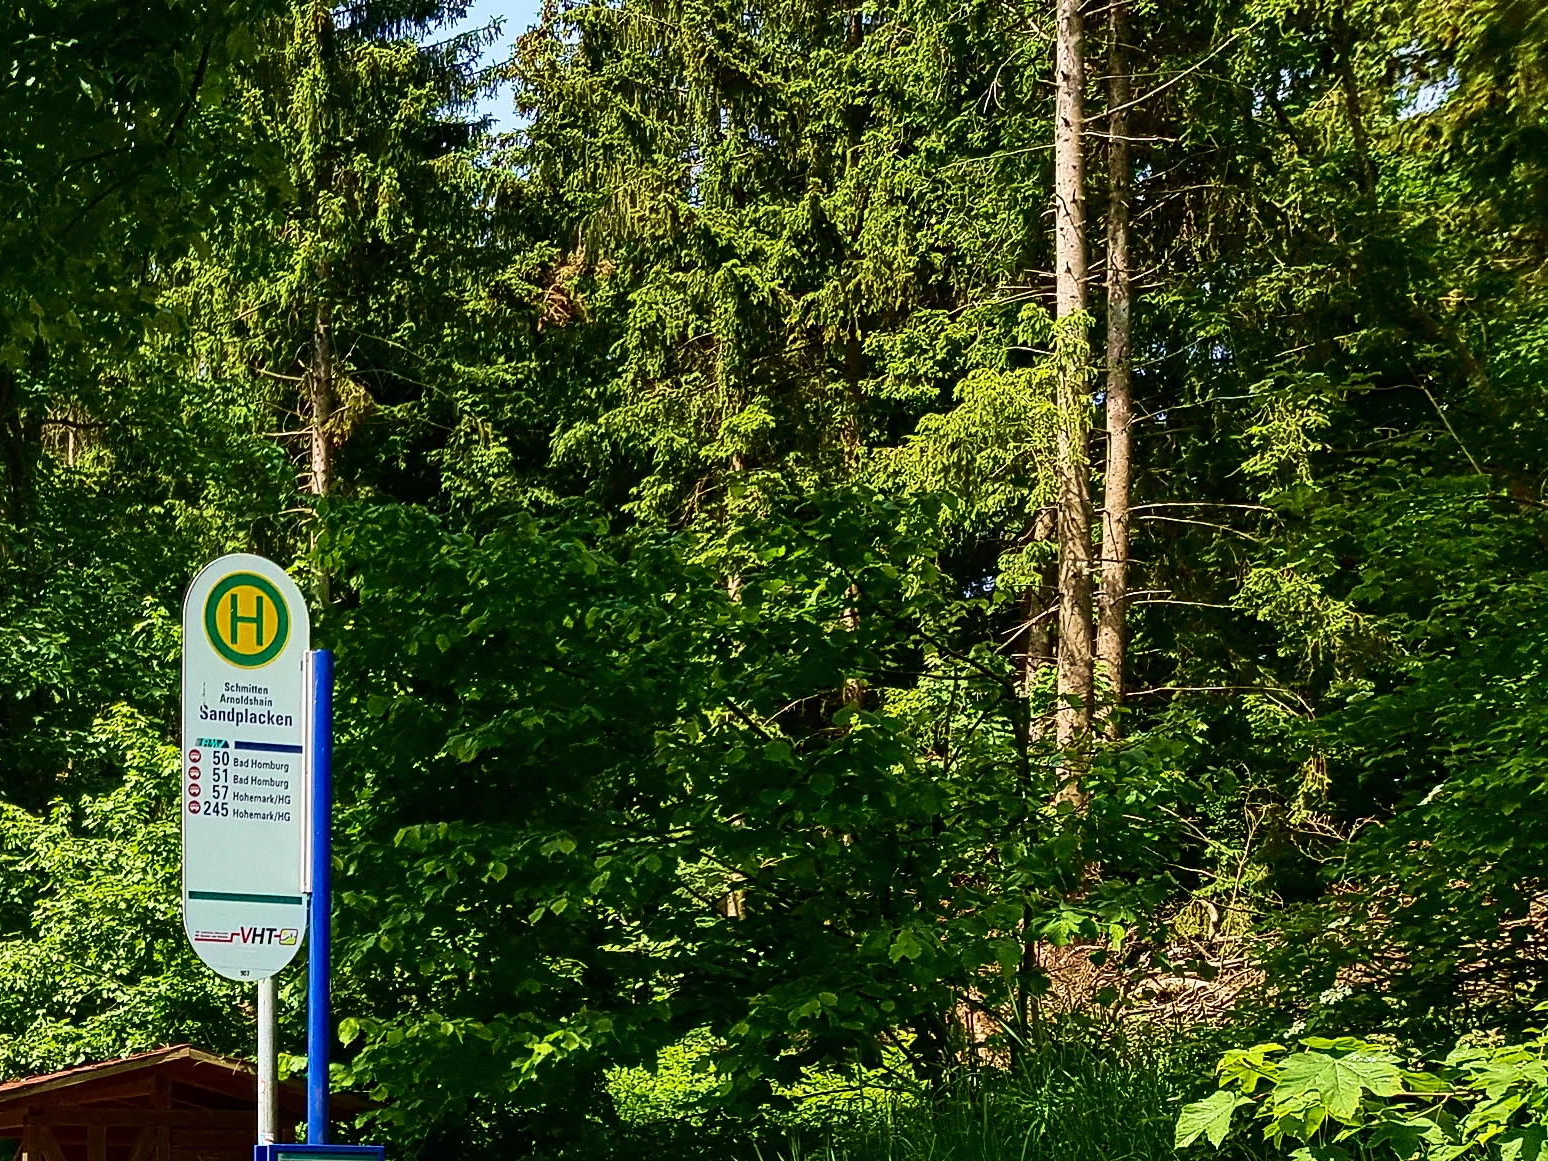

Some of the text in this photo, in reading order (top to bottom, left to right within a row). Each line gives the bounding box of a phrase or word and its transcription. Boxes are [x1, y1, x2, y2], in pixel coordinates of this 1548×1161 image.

[230, 594, 264, 646] H
[224, 682, 268, 695] Schmitten
[219, 694, 273, 707] Arnoldshain
[199, 704, 293, 727] Sandplacken
[212, 751, 289, 773] 50 Bad Homburg
[212, 768, 289, 790] 51 Bad Homburg
[212, 785, 291, 805] 57 Hohemark/HG
[203, 801, 291, 822] 245 Hohemark/HG
[240, 926, 277, 944] VHT
